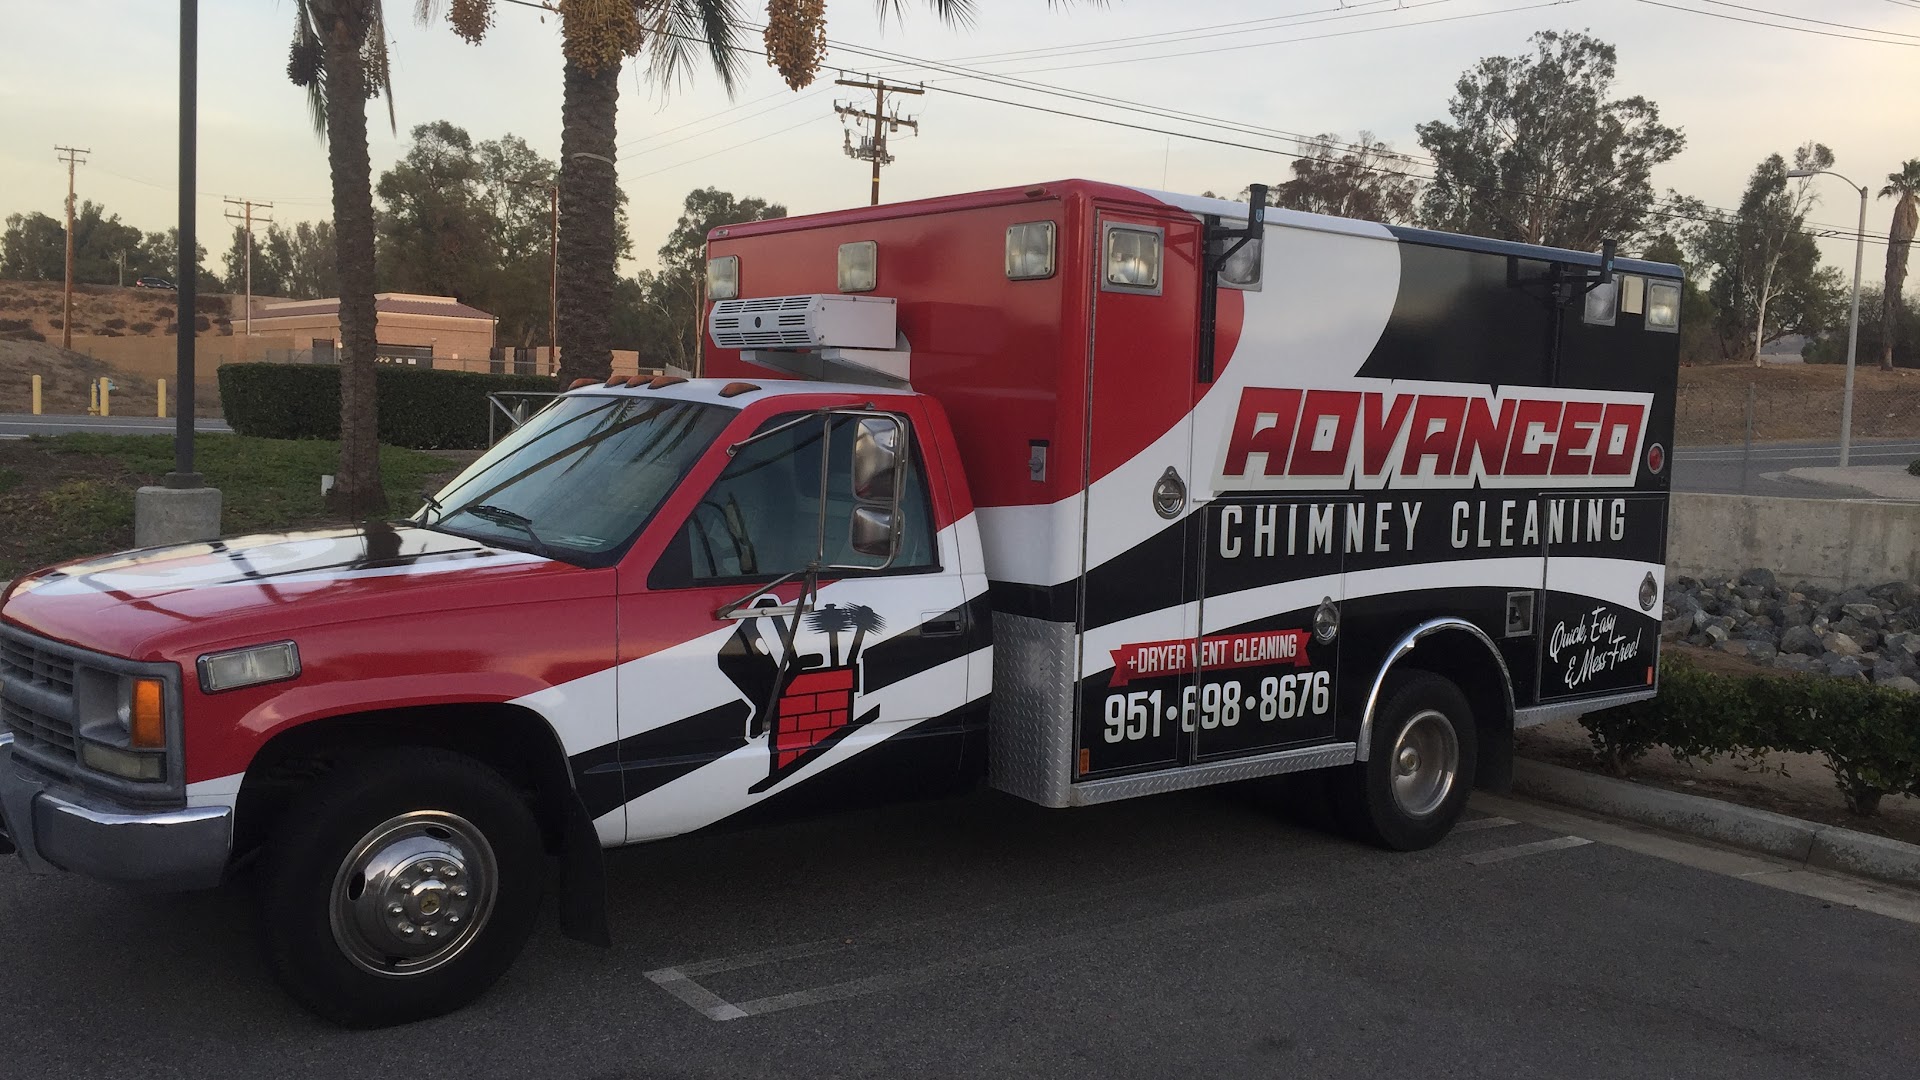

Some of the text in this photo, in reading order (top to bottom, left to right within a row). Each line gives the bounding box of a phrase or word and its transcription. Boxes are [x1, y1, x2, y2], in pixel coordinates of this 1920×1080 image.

[1222, 386, 1646, 477] ADVANCED
[1219, 498, 1626, 559] CHIMNEY CLEANING
[1233, 634, 1298, 662] CLEANING
[1550, 606, 1618, 663] Quick, Easy
